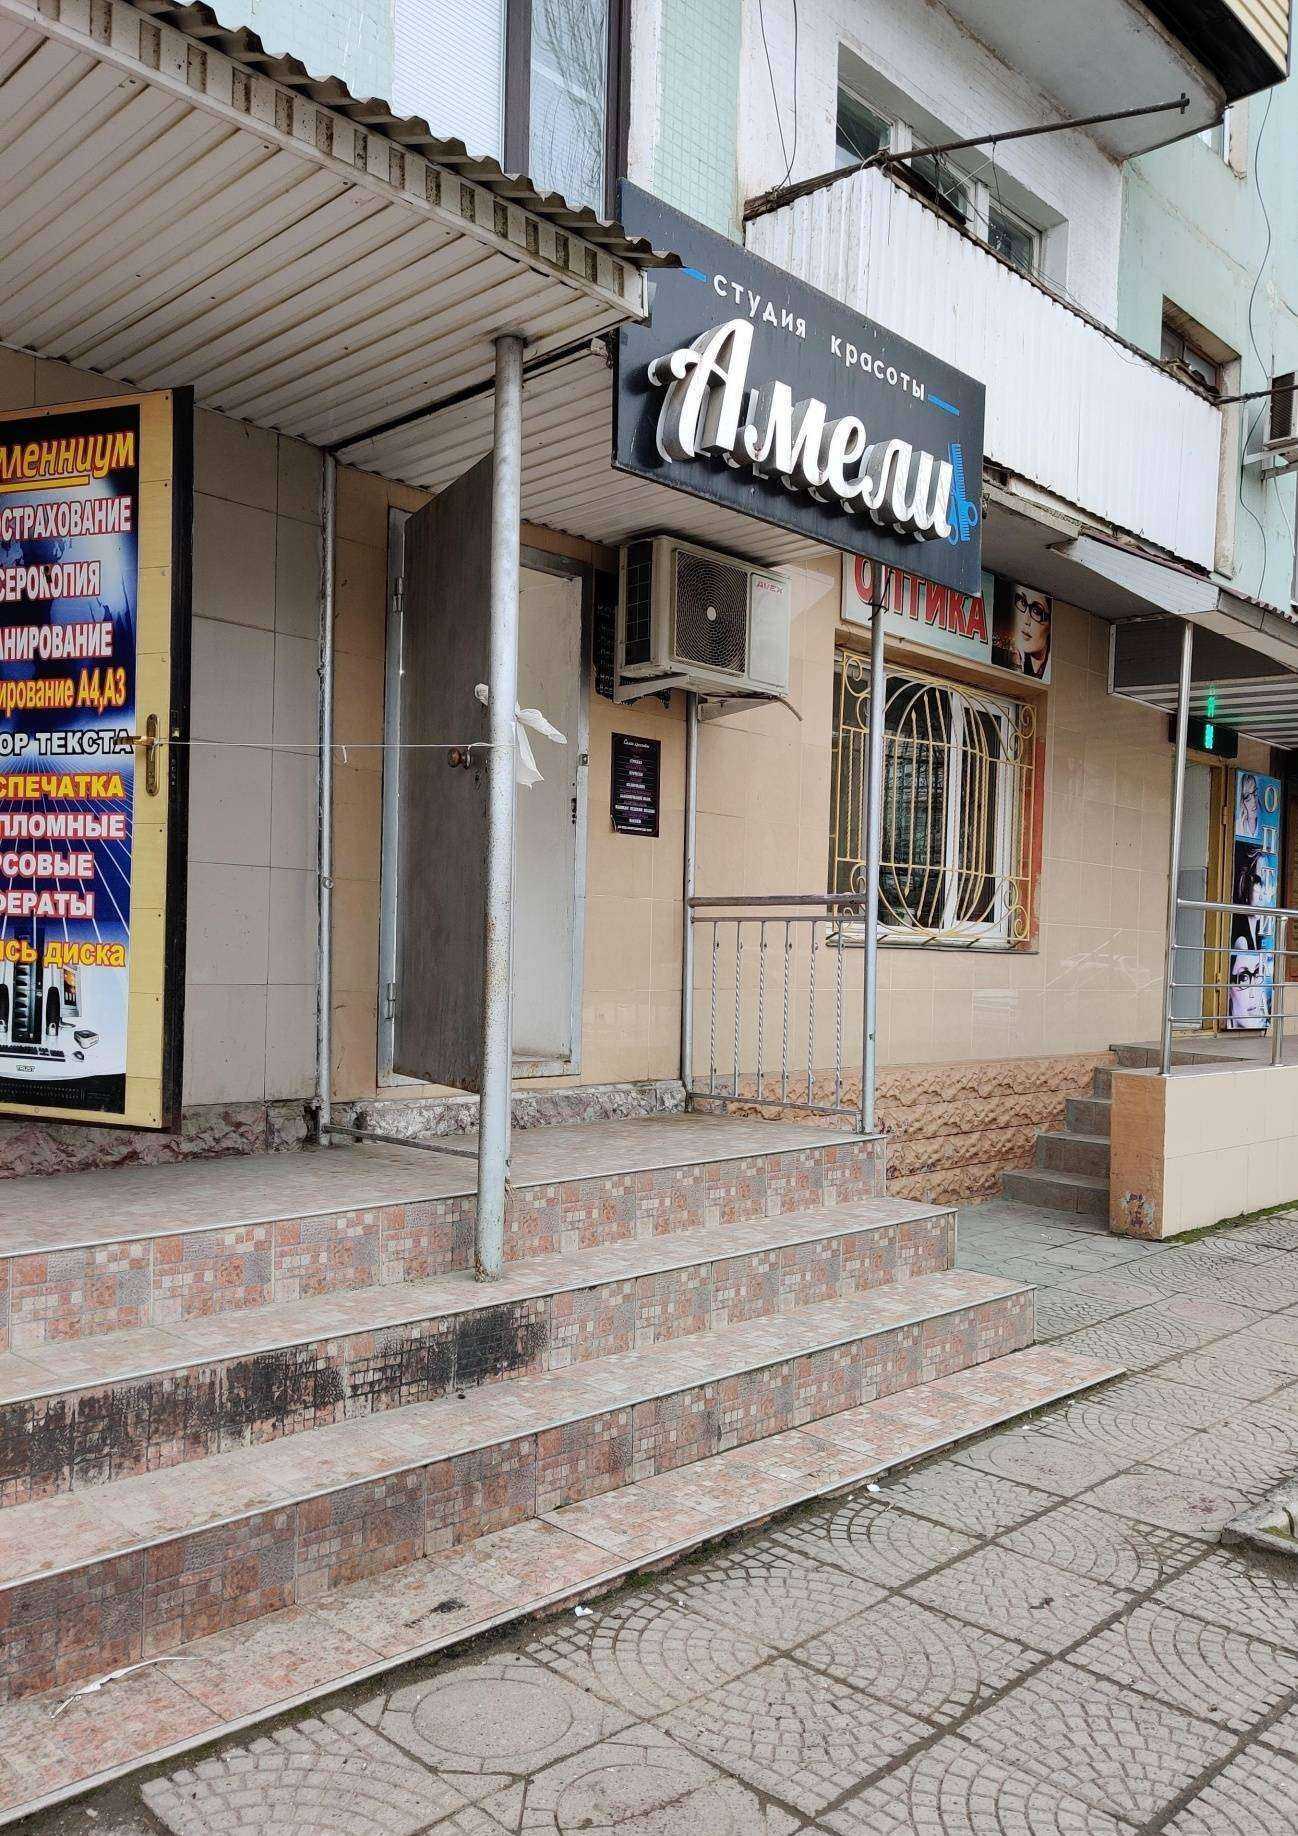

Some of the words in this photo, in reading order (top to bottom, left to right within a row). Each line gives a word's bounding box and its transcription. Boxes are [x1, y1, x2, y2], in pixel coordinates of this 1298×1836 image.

[713, 273, 808, 340] студия
[830, 334, 926, 401] красоты
[647, 318, 955, 543] Амели
[0, 431, 135, 481] ленниум
[0, 621, 114, 661] НИРОВАНИЕ
[35, 729, 134, 755] ТЕКСТА
[0, 852, 94, 878] СОВЫЕ
[43, 941, 125, 968] диска
